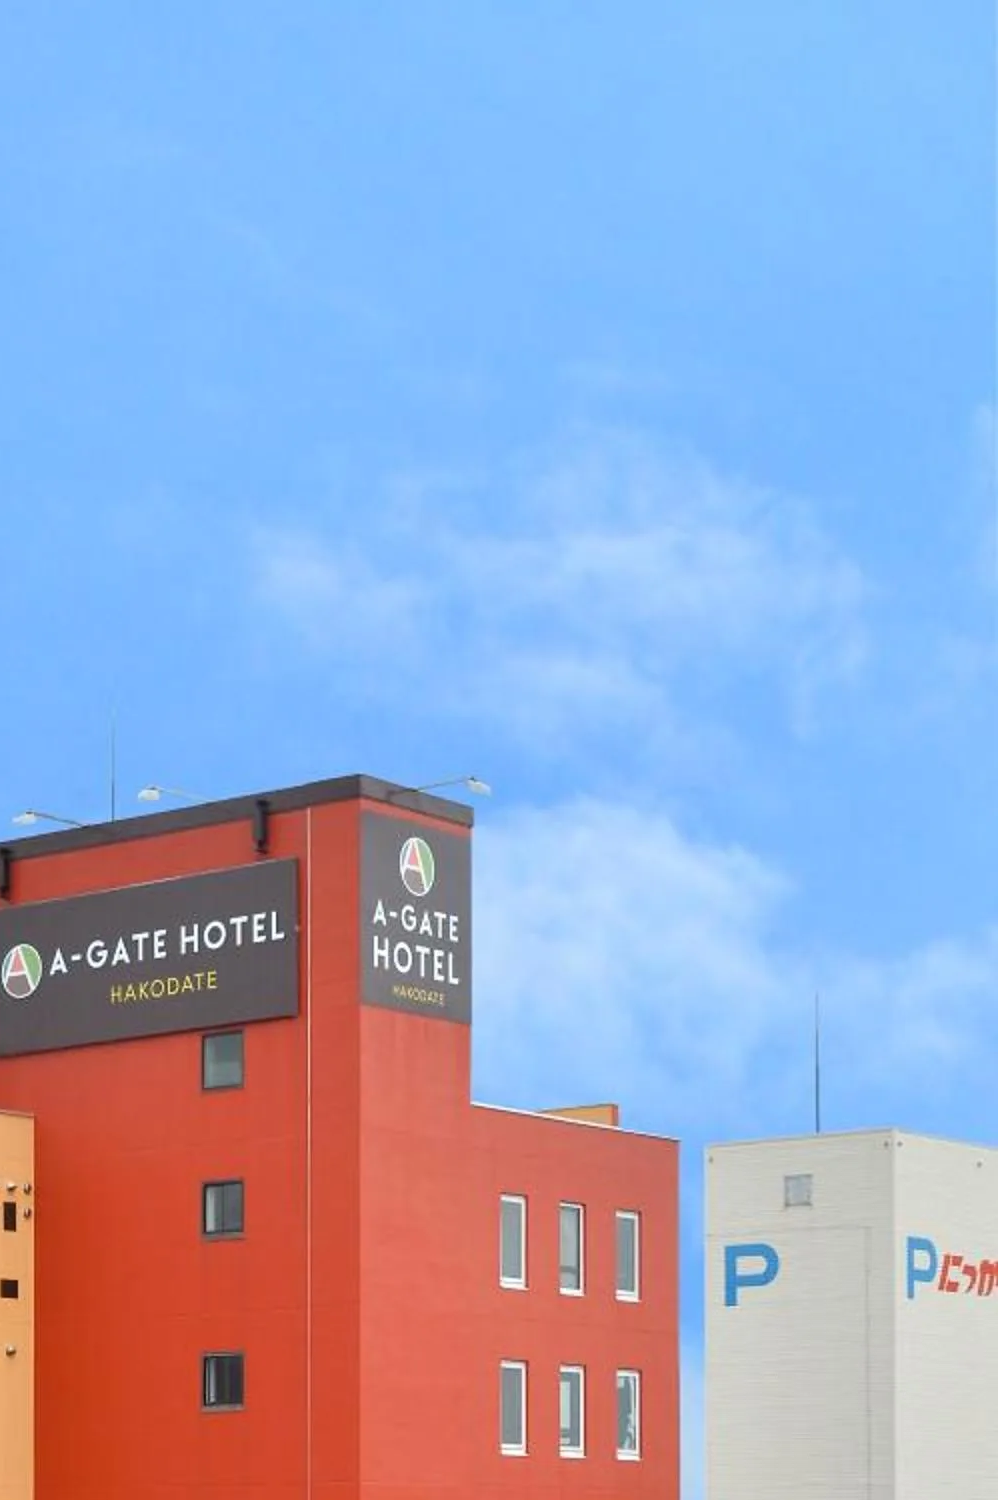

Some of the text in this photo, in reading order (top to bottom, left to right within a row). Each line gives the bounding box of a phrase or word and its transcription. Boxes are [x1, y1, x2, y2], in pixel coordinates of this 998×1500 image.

[49, 928, 167, 976] A-GATE
[179, 910, 285, 955] HOTEL
[373, 899, 460, 943] A-GATE
[373, 938, 460, 986] HOTEL
[110, 971, 218, 1005] HAKODATE
[392, 985, 445, 1007] HAKODATE
[724, 1242, 780, 1307] P
[907, 1235, 937, 1300] P
